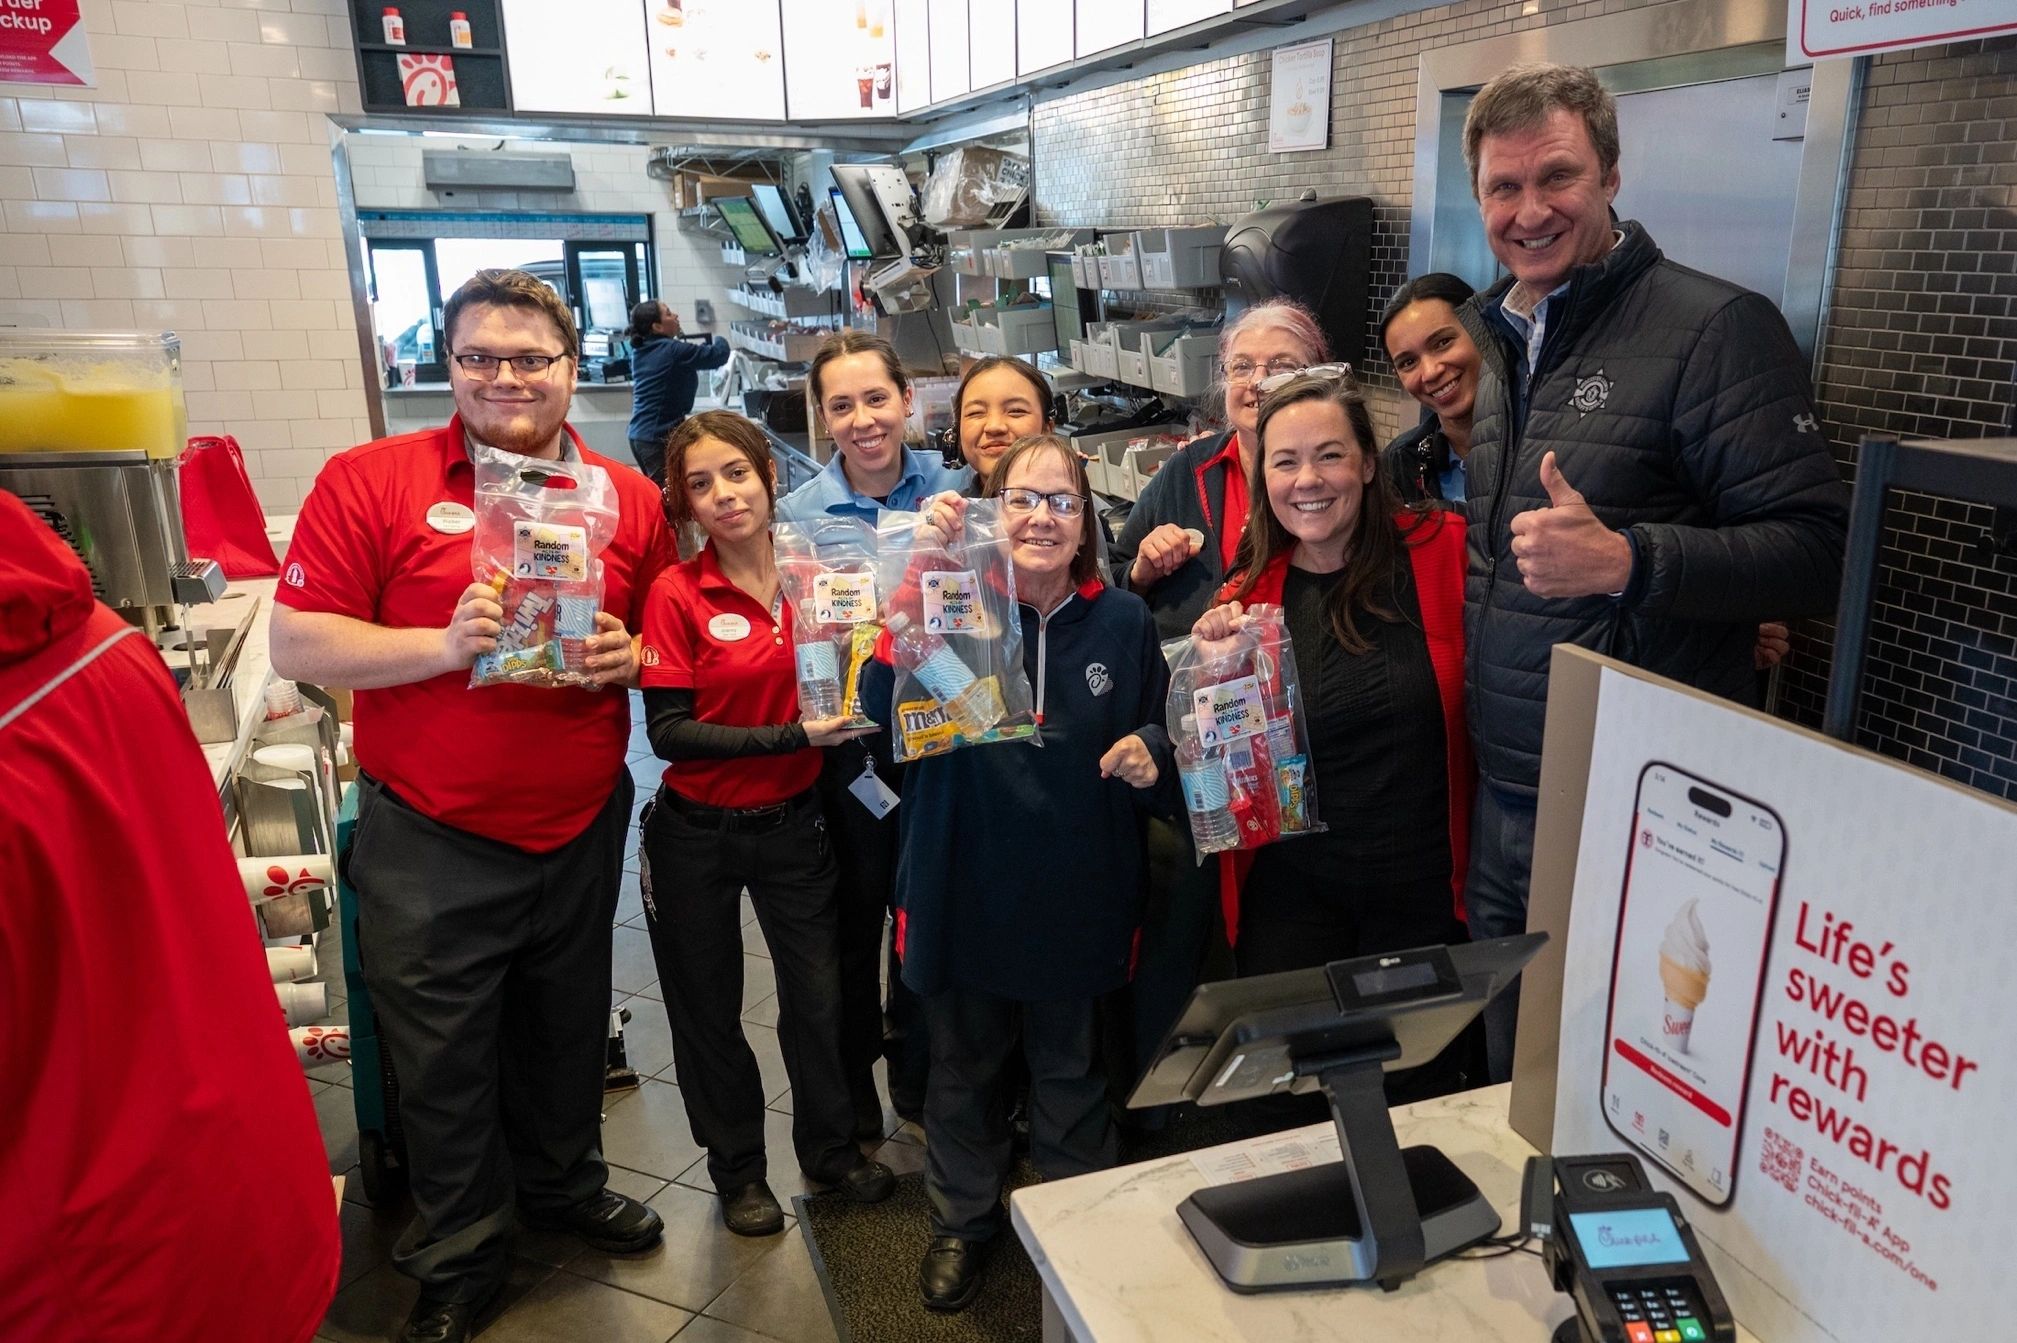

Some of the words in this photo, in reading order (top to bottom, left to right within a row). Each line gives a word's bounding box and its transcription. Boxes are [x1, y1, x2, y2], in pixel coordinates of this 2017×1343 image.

[1830, 7, 1865, 23] Quick,
[1869, 4, 1891, 17] find
[534, 540, 569, 551] Random
[533, 552, 570, 564] KINDNESS
[831, 588, 861, 597] Random
[942, 589, 971, 600] Random
[831, 599, 863, 608] KINDNESS
[942, 604, 973, 614] KINDNESS
[1213, 697, 1246, 713] Random
[1215, 709, 1250, 726] KINDNESS
[1795, 901, 1910, 997] Life's
[1785, 967, 1978, 1091] sweeter
[1776, 1020, 1868, 1102] with
[1769, 1072, 1952, 1211] rewards
[1810, 1156, 1839, 1184] Earn
[1840, 1181, 1883, 1214] points
[1804, 1193, 1938, 1291] chick-fil-a.com/one
[1882, 1226, 1911, 1252] App
